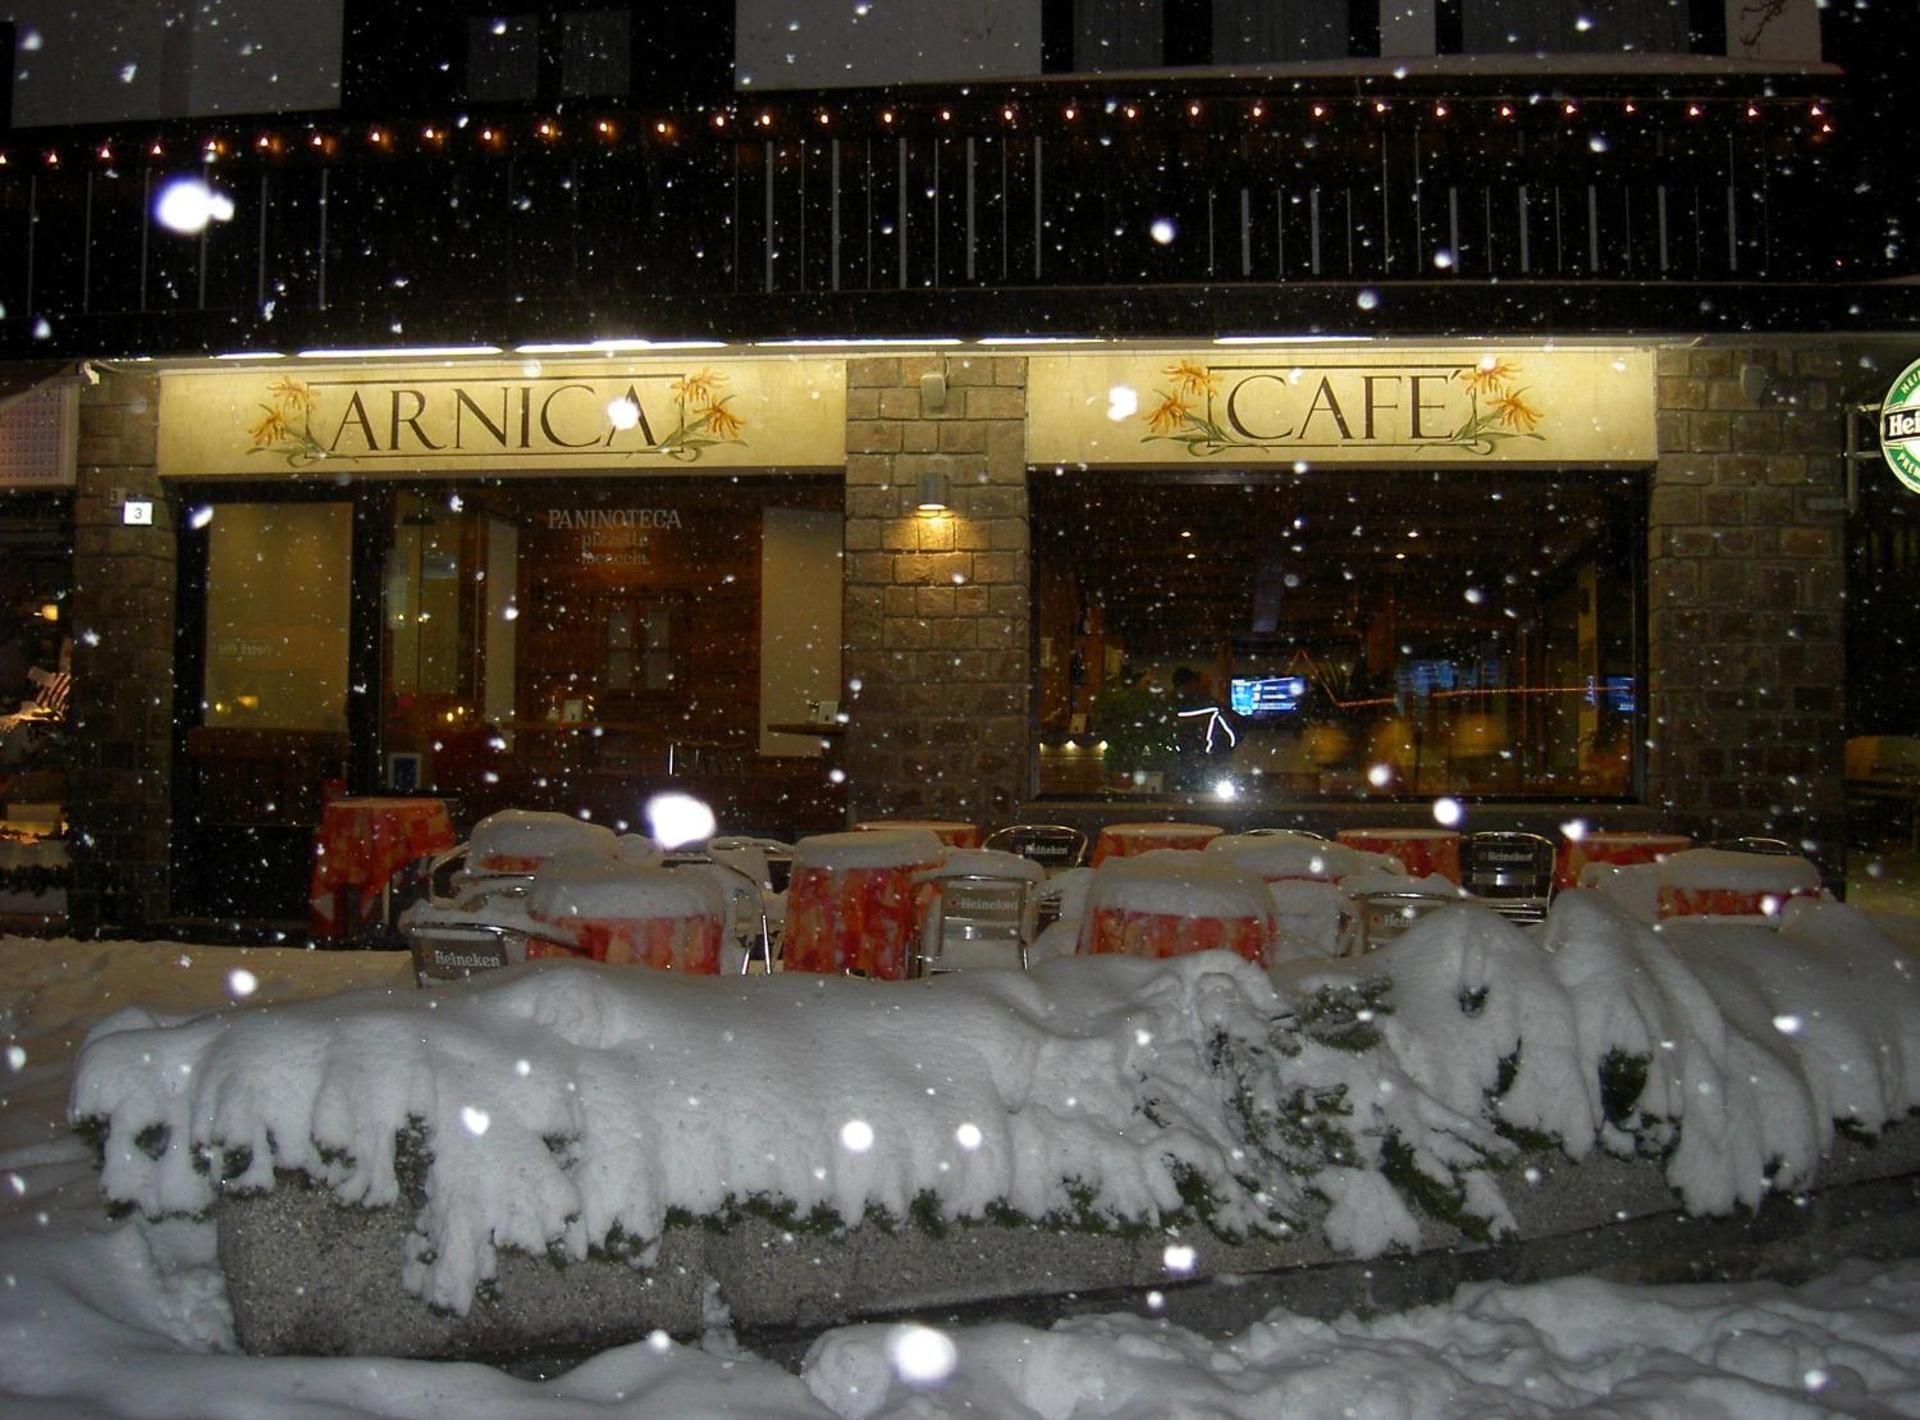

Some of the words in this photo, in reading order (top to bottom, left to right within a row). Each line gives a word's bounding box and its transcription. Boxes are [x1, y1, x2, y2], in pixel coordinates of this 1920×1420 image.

[329, 384, 657, 452] ARNICA
[134, 507, 143, 519] 3
[548, 509, 683, 530] PANINOTECA
[435, 951, 500, 967] Heineken
